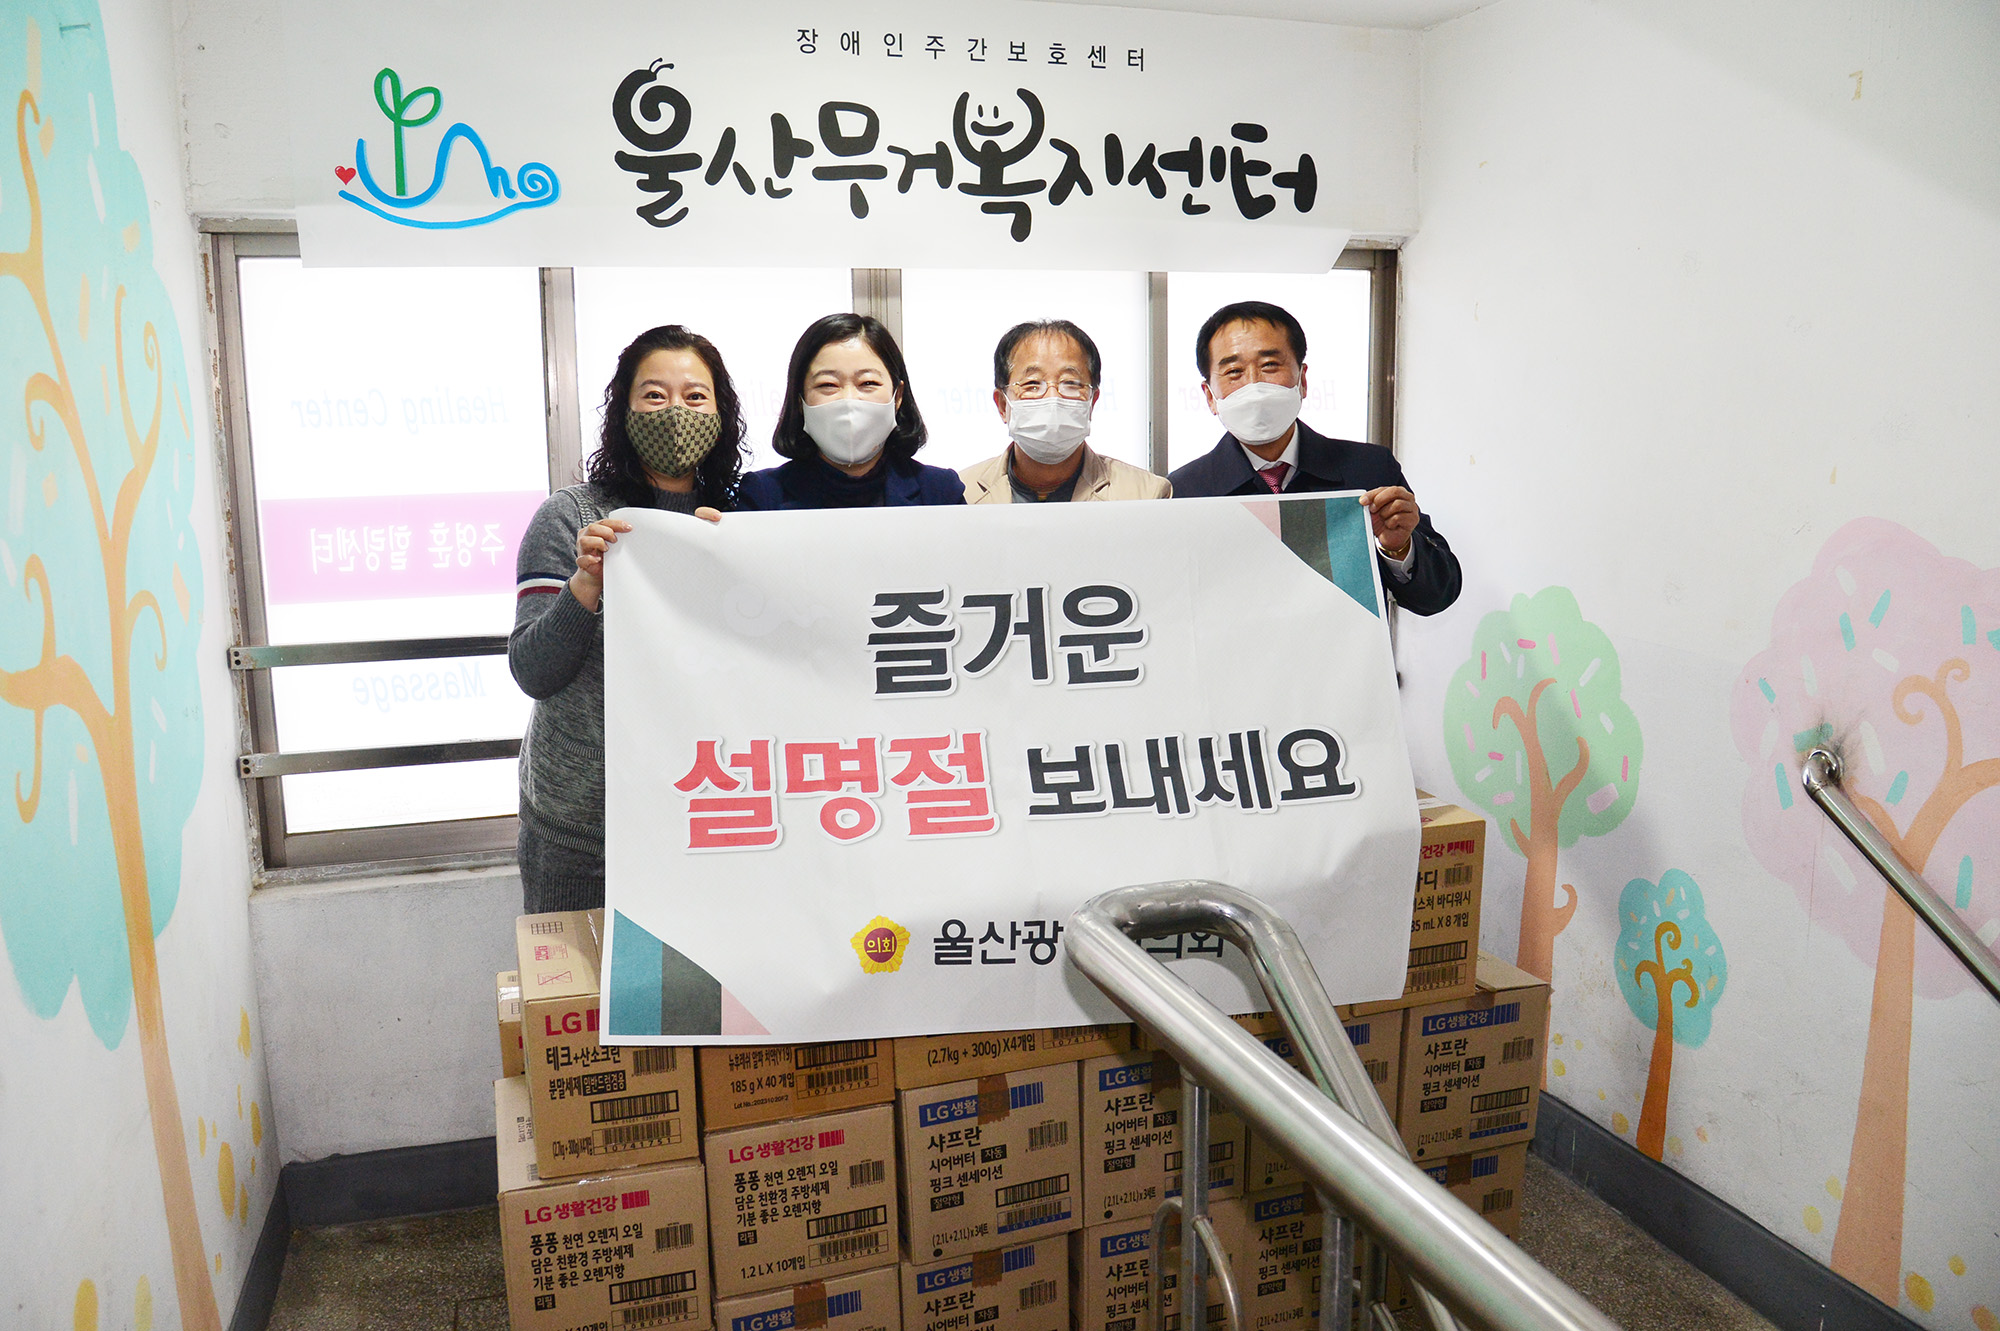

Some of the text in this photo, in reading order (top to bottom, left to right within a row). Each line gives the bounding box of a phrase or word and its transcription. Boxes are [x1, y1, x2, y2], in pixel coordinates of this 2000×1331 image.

[796, 27, 1148, 73] 장애인주간보호센터
[612, 57, 1318, 243] 울산무거복지센터
[869, 587, 1144, 694] 즐거운
[675, 730, 1356, 849] 설명절 보내세요
[1437, 890, 1471, 909] 바디워시
[866, 936, 895, 953] 의회
[545, 1011, 582, 1036] LG
[927, 1047, 959, 1067] (2.7kg
[971, 1039, 1000, 1059] 300g)
[1003, 1033, 1036, 1052] X4개입
[1424, 1038, 1468, 1060] 샤프란
[1423, 1060, 1461, 1078] 시어버터
[549, 1076, 582, 1100] 분말세제
[731, 1079, 747, 1093] 185
[749, 1081, 755, 1094] g
[765, 1075, 777, 1088] 40
[779, 1072, 795, 1088] 개입
[1422, 1074, 1480, 1096] 핑크 센세이션
[926, 1099, 978, 1122] LG생활
[1104, 1092, 1155, 1116] 샤프란
[1105, 1116, 1148, 1135] 시어버터
[927, 1126, 982, 1153] 샤프란
[1104, 1130, 1172, 1155] 핑크 센세이션
[929, 1147, 1003, 1173] 시어버터 자동
[733, 1160, 838, 1193] 퐁퐁 천연 오렌지 오일
[929, 1164, 1003, 1193] 핑크 센세이션
[735, 1194, 755, 1211] 담은
[758, 1188, 788, 1207] 친환경
[791, 1180, 830, 1199] 주방세제
[736, 1200, 821, 1227] 기분 좋은 오렌지향
[529, 1222, 643, 1256] 퐁퐁 천연 오렌지 오일
[1258, 1220, 1304, 1244] 샤프란
[531, 1257, 553, 1275] 담은
[556, 1251, 588, 1271] 친환경
[591, 1243, 634, 1263] 주방세제
[1259, 1243, 1298, 1262] 시어버터
[533, 1264, 625, 1292] 기분 좋은 오렌지향
[741, 1266, 756, 1279] 1.2
[776, 1255, 806, 1271] 10개입
[924, 1267, 973, 1289] LG생활
[1258, 1255, 1320, 1280] 핑크 센세이션
[923, 1290, 976, 1316] 샤프란
[1106, 1281, 1148, 1300] 시어버터
[925, 1312, 969, 1331] 시어버터
[1106, 1303, 1128, 1318] 핑크
